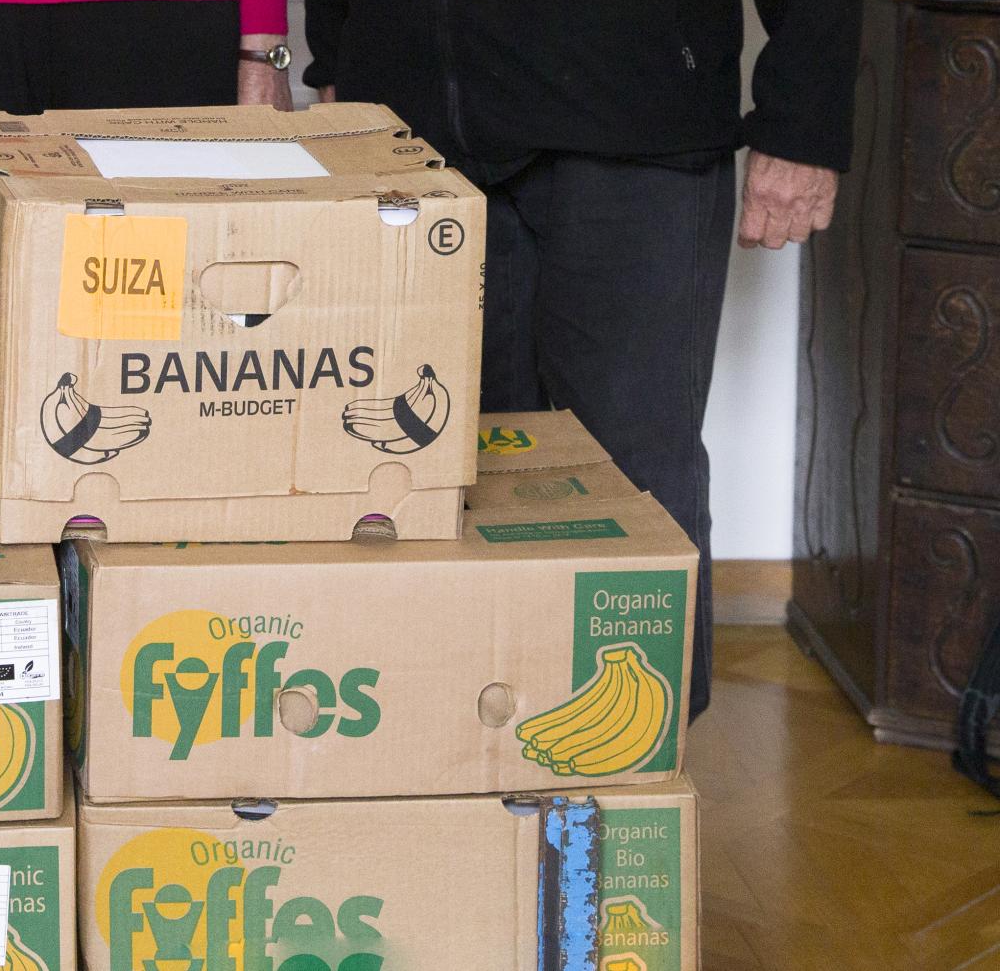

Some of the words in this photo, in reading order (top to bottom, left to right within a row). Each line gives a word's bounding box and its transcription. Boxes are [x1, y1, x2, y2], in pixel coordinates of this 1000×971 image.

[439, 225, 453, 247] E
[82, 256, 165, 295] SUIZA
[120, 346, 375, 395] BANANAS
[199, 399, 296, 418] M-BUDGET
[593, 589, 672, 615] Organic
[208, 614, 303, 640] Organic
[590, 617, 673, 637] Bananas
[132, 641, 382, 761] fyffes
[190, 838, 296, 866] Organic
[616, 849, 644, 867] Bio
[600, 875, 669, 889] ananas
[603, 931, 669, 946] ananas
